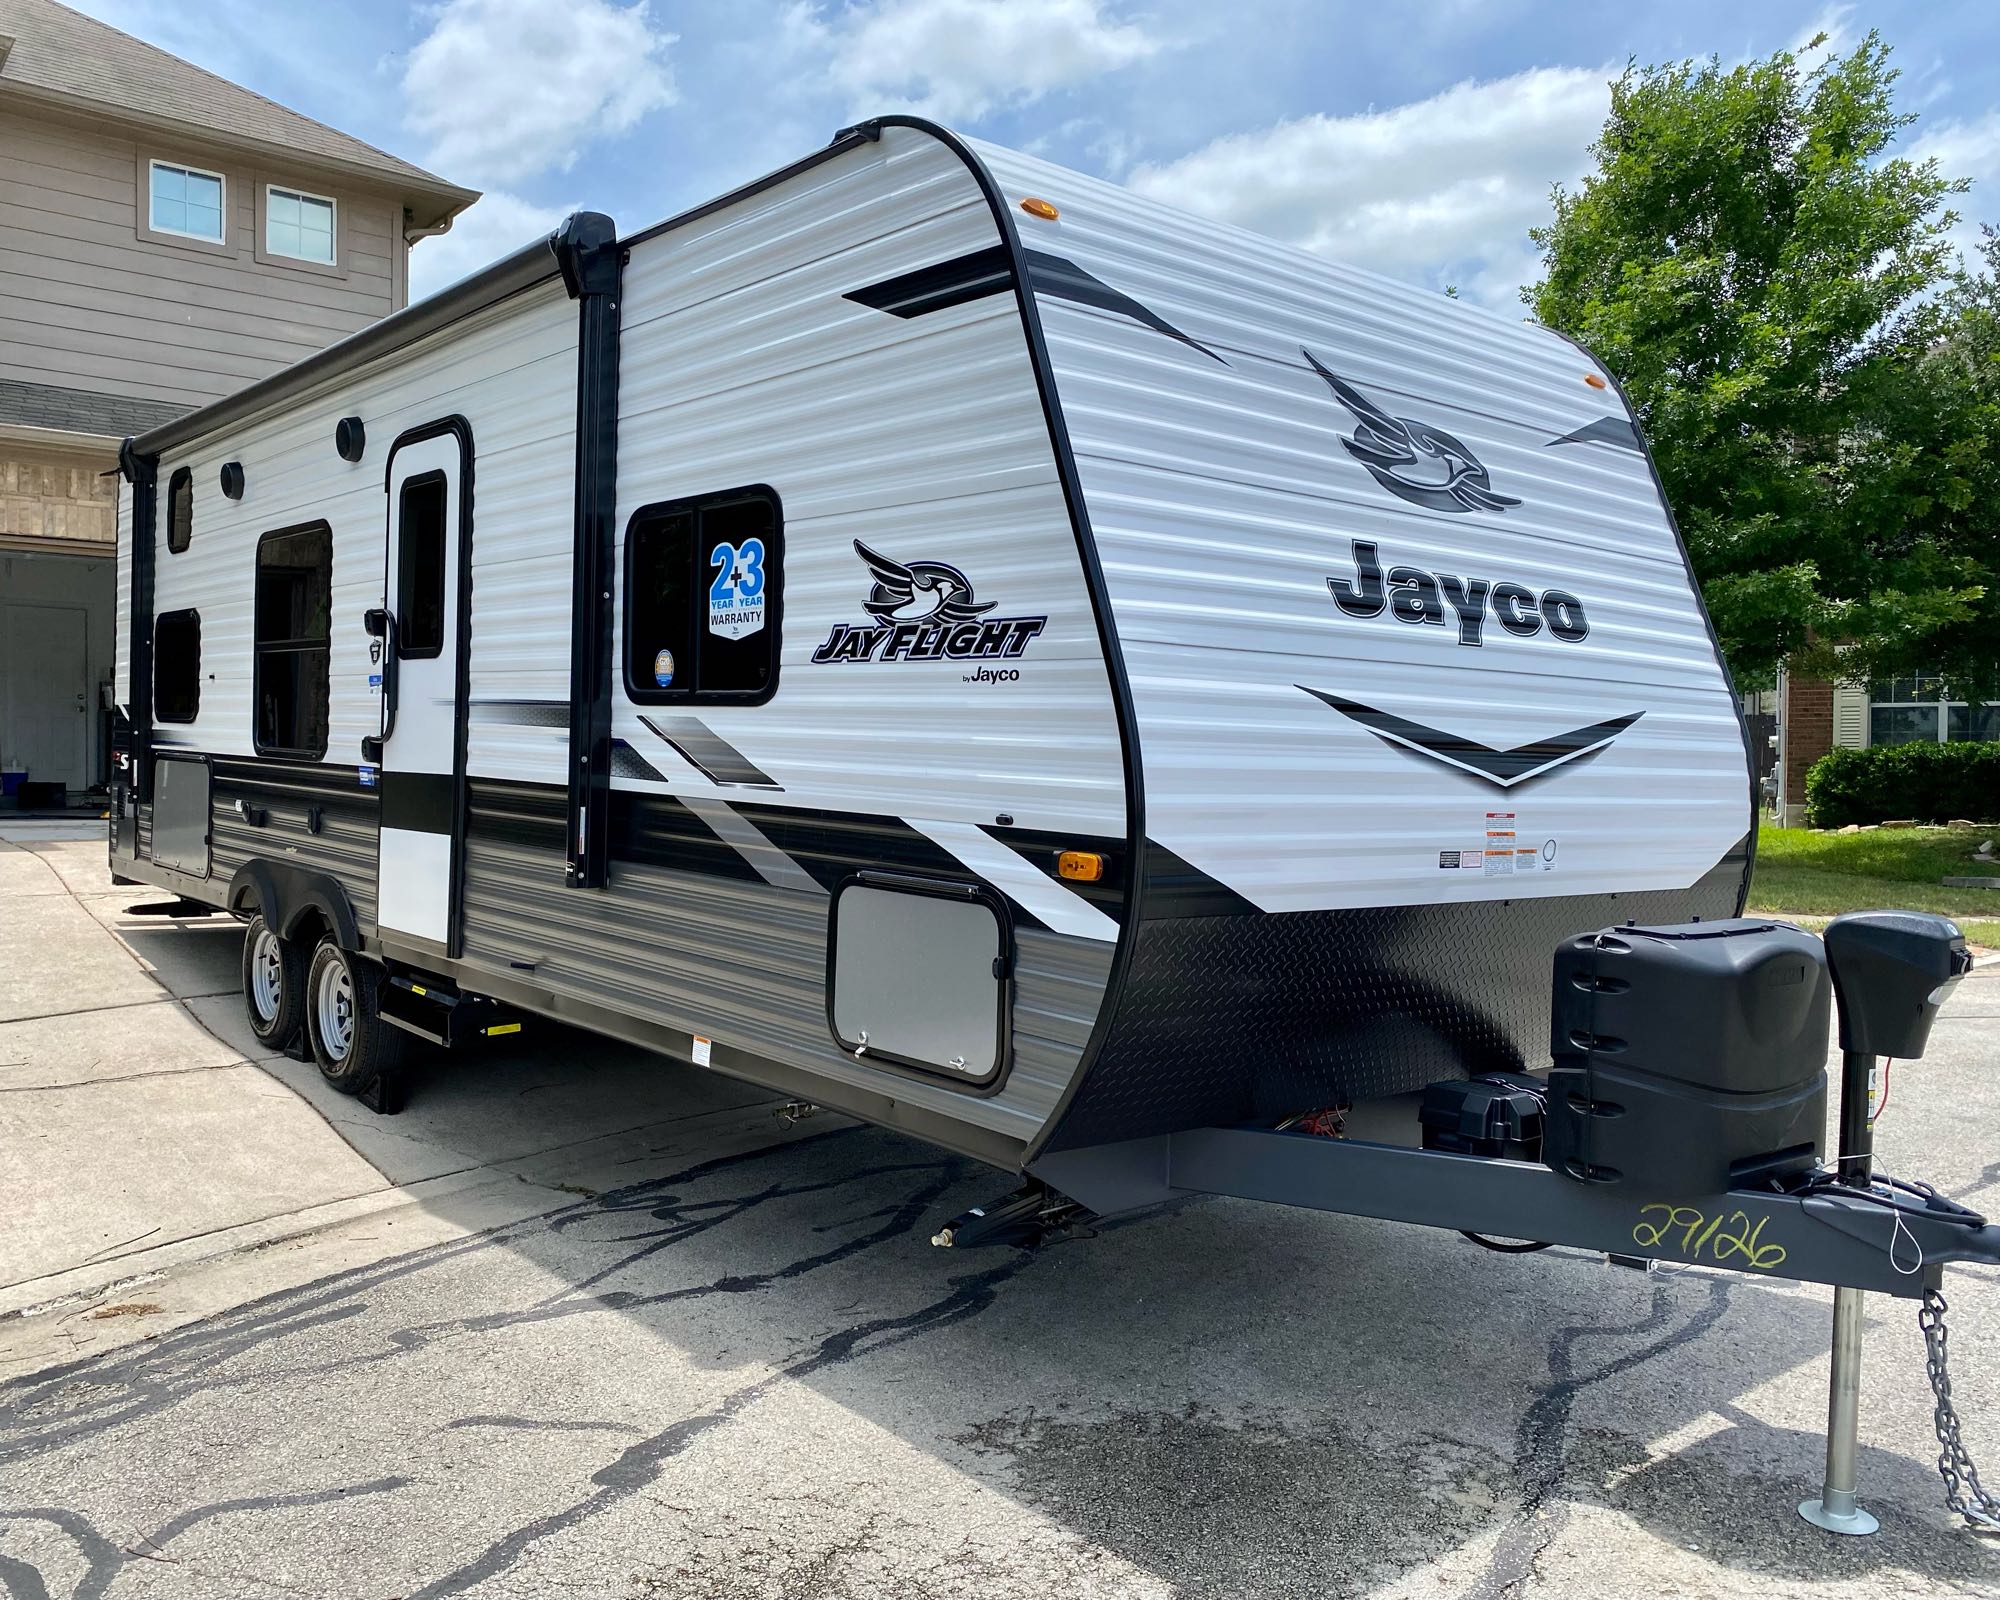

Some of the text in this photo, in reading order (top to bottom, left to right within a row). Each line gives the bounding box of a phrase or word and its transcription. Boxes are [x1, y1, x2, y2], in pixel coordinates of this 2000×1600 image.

[1326, 538, 1590, 647] Jayco
[712, 600, 734, 610] YEAR
[739, 596, 763, 607] YEAR
[711, 611, 762, 625] WARRANTY
[971, 667, 1020, 684] Jayco
[1632, 1203, 1786, 1269] 29126
